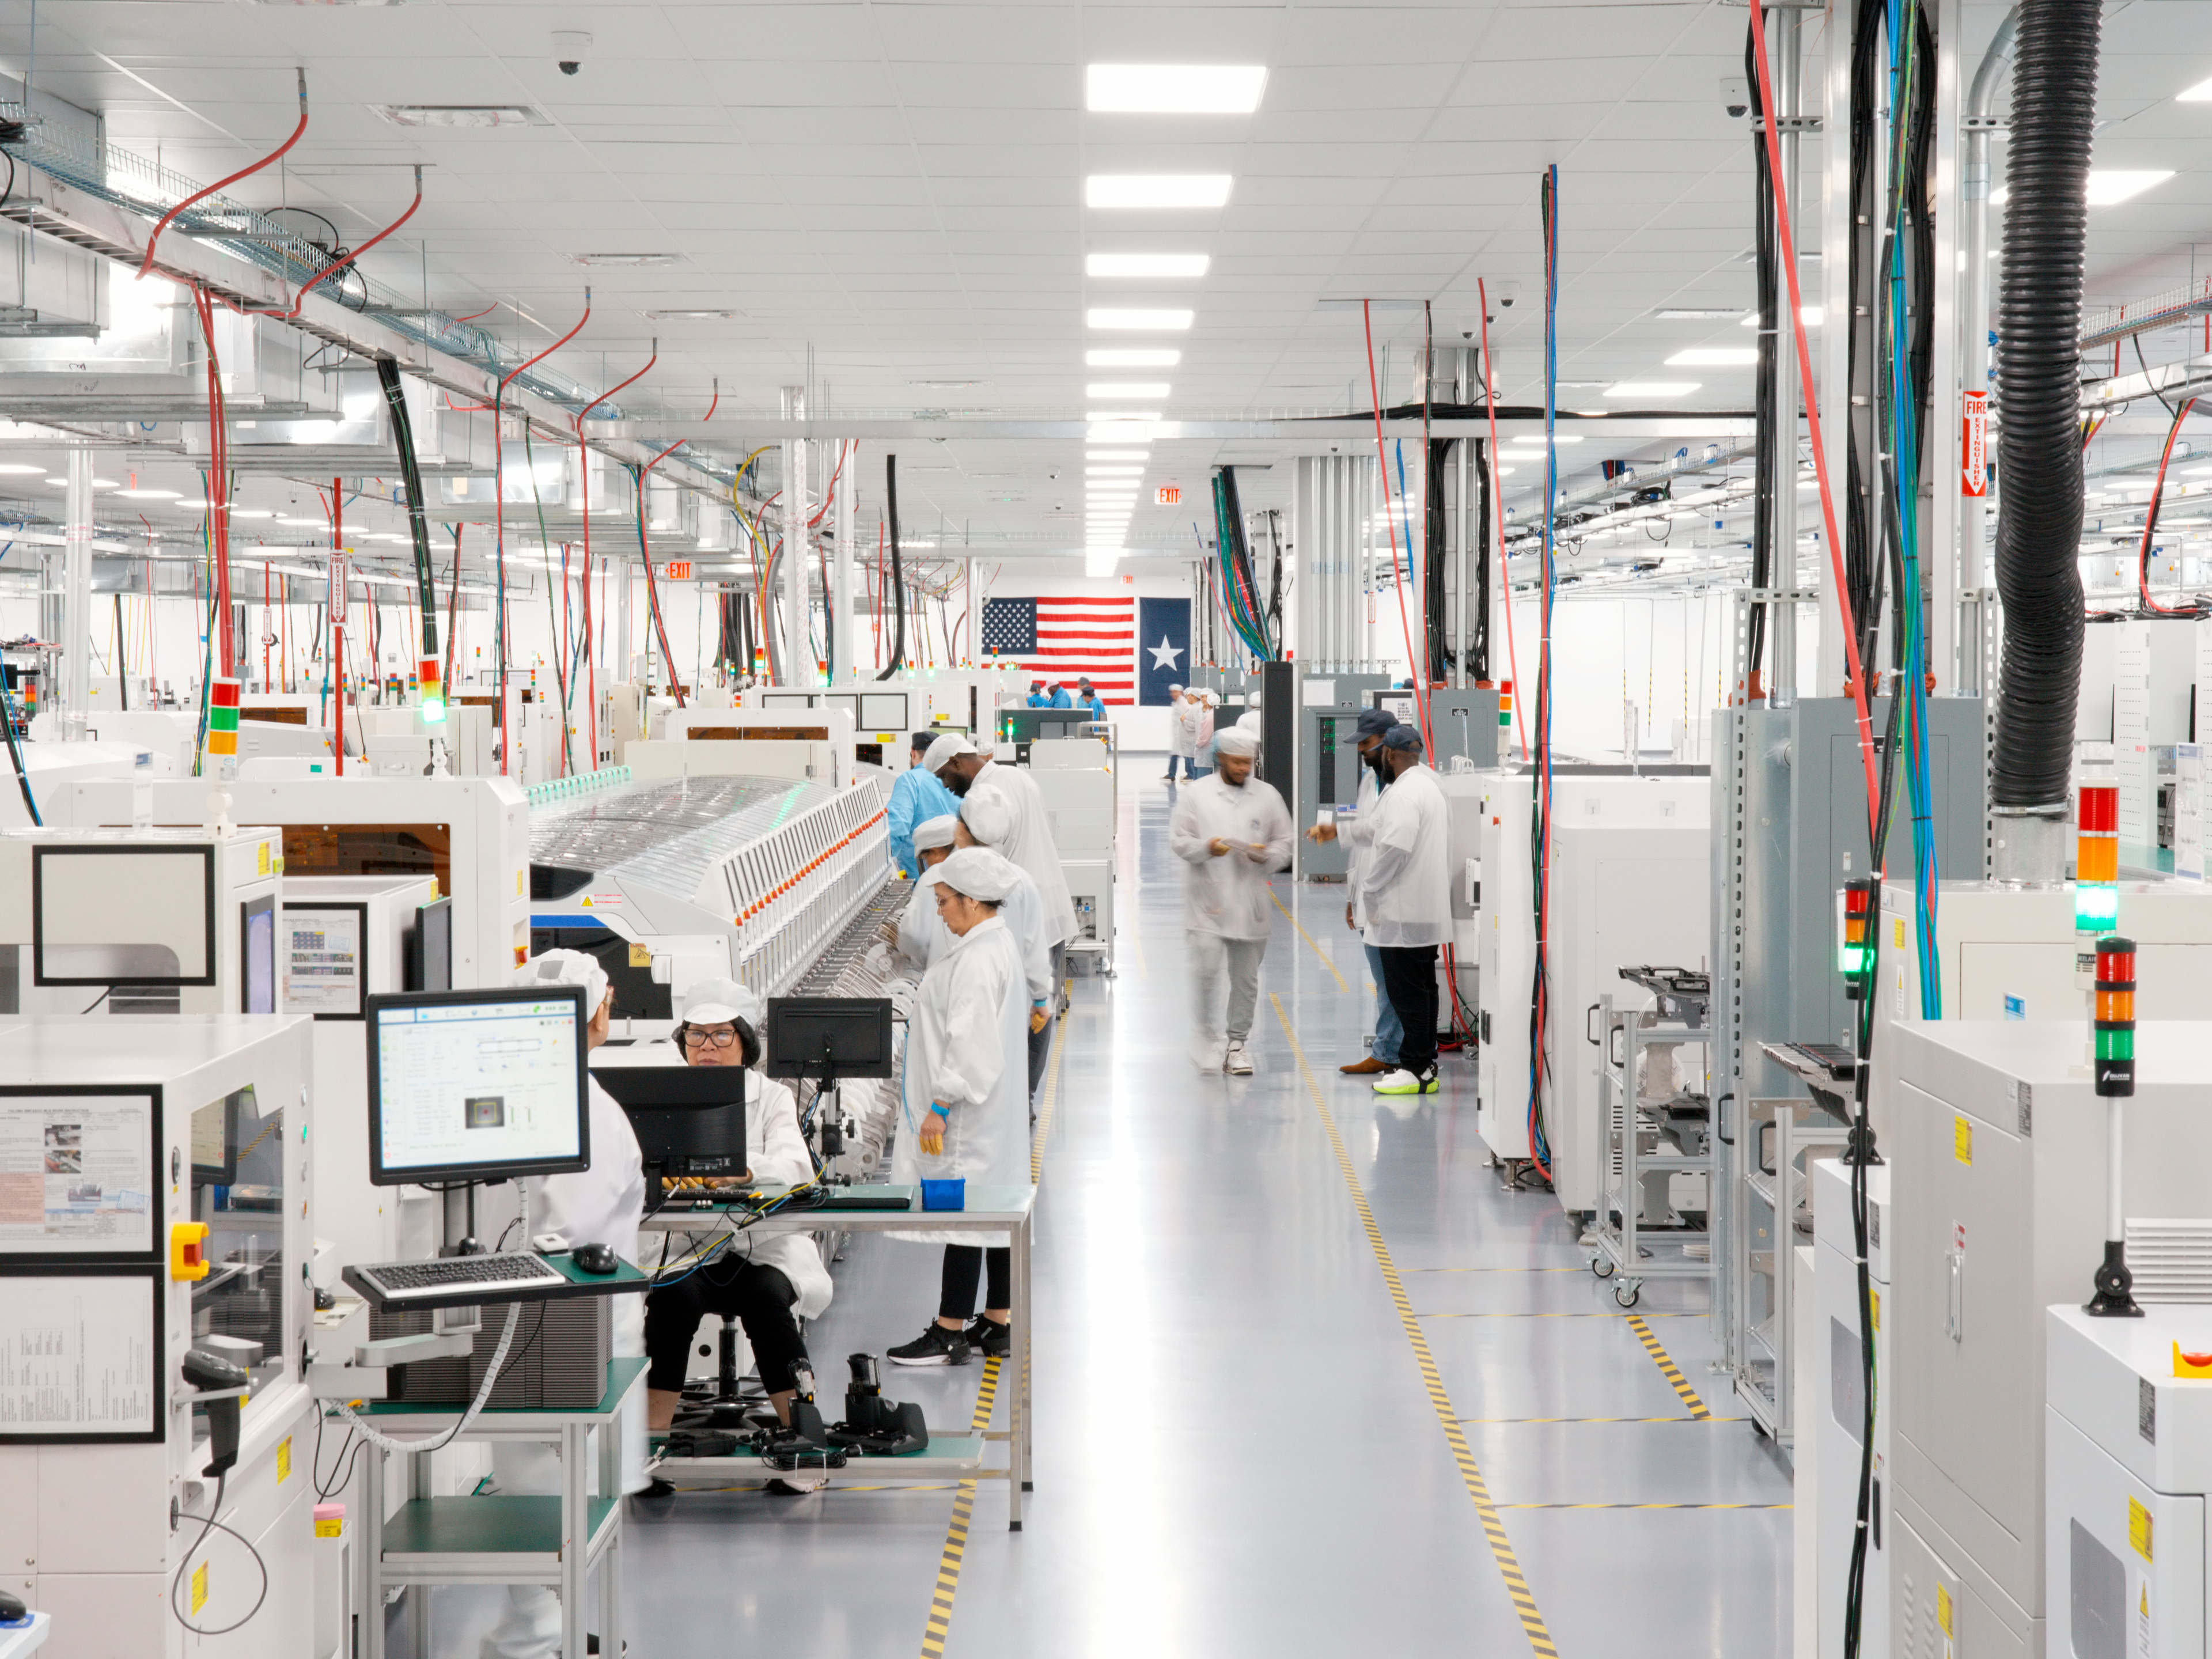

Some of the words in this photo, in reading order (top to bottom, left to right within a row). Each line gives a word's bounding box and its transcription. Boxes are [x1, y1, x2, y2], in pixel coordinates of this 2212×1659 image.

[1967, 401, 1987, 414] FIRE
[1160, 488, 1179, 503] EXIT
[669, 562, 691, 579] EXIT
[1123, 575, 1133, 584] EXIT
